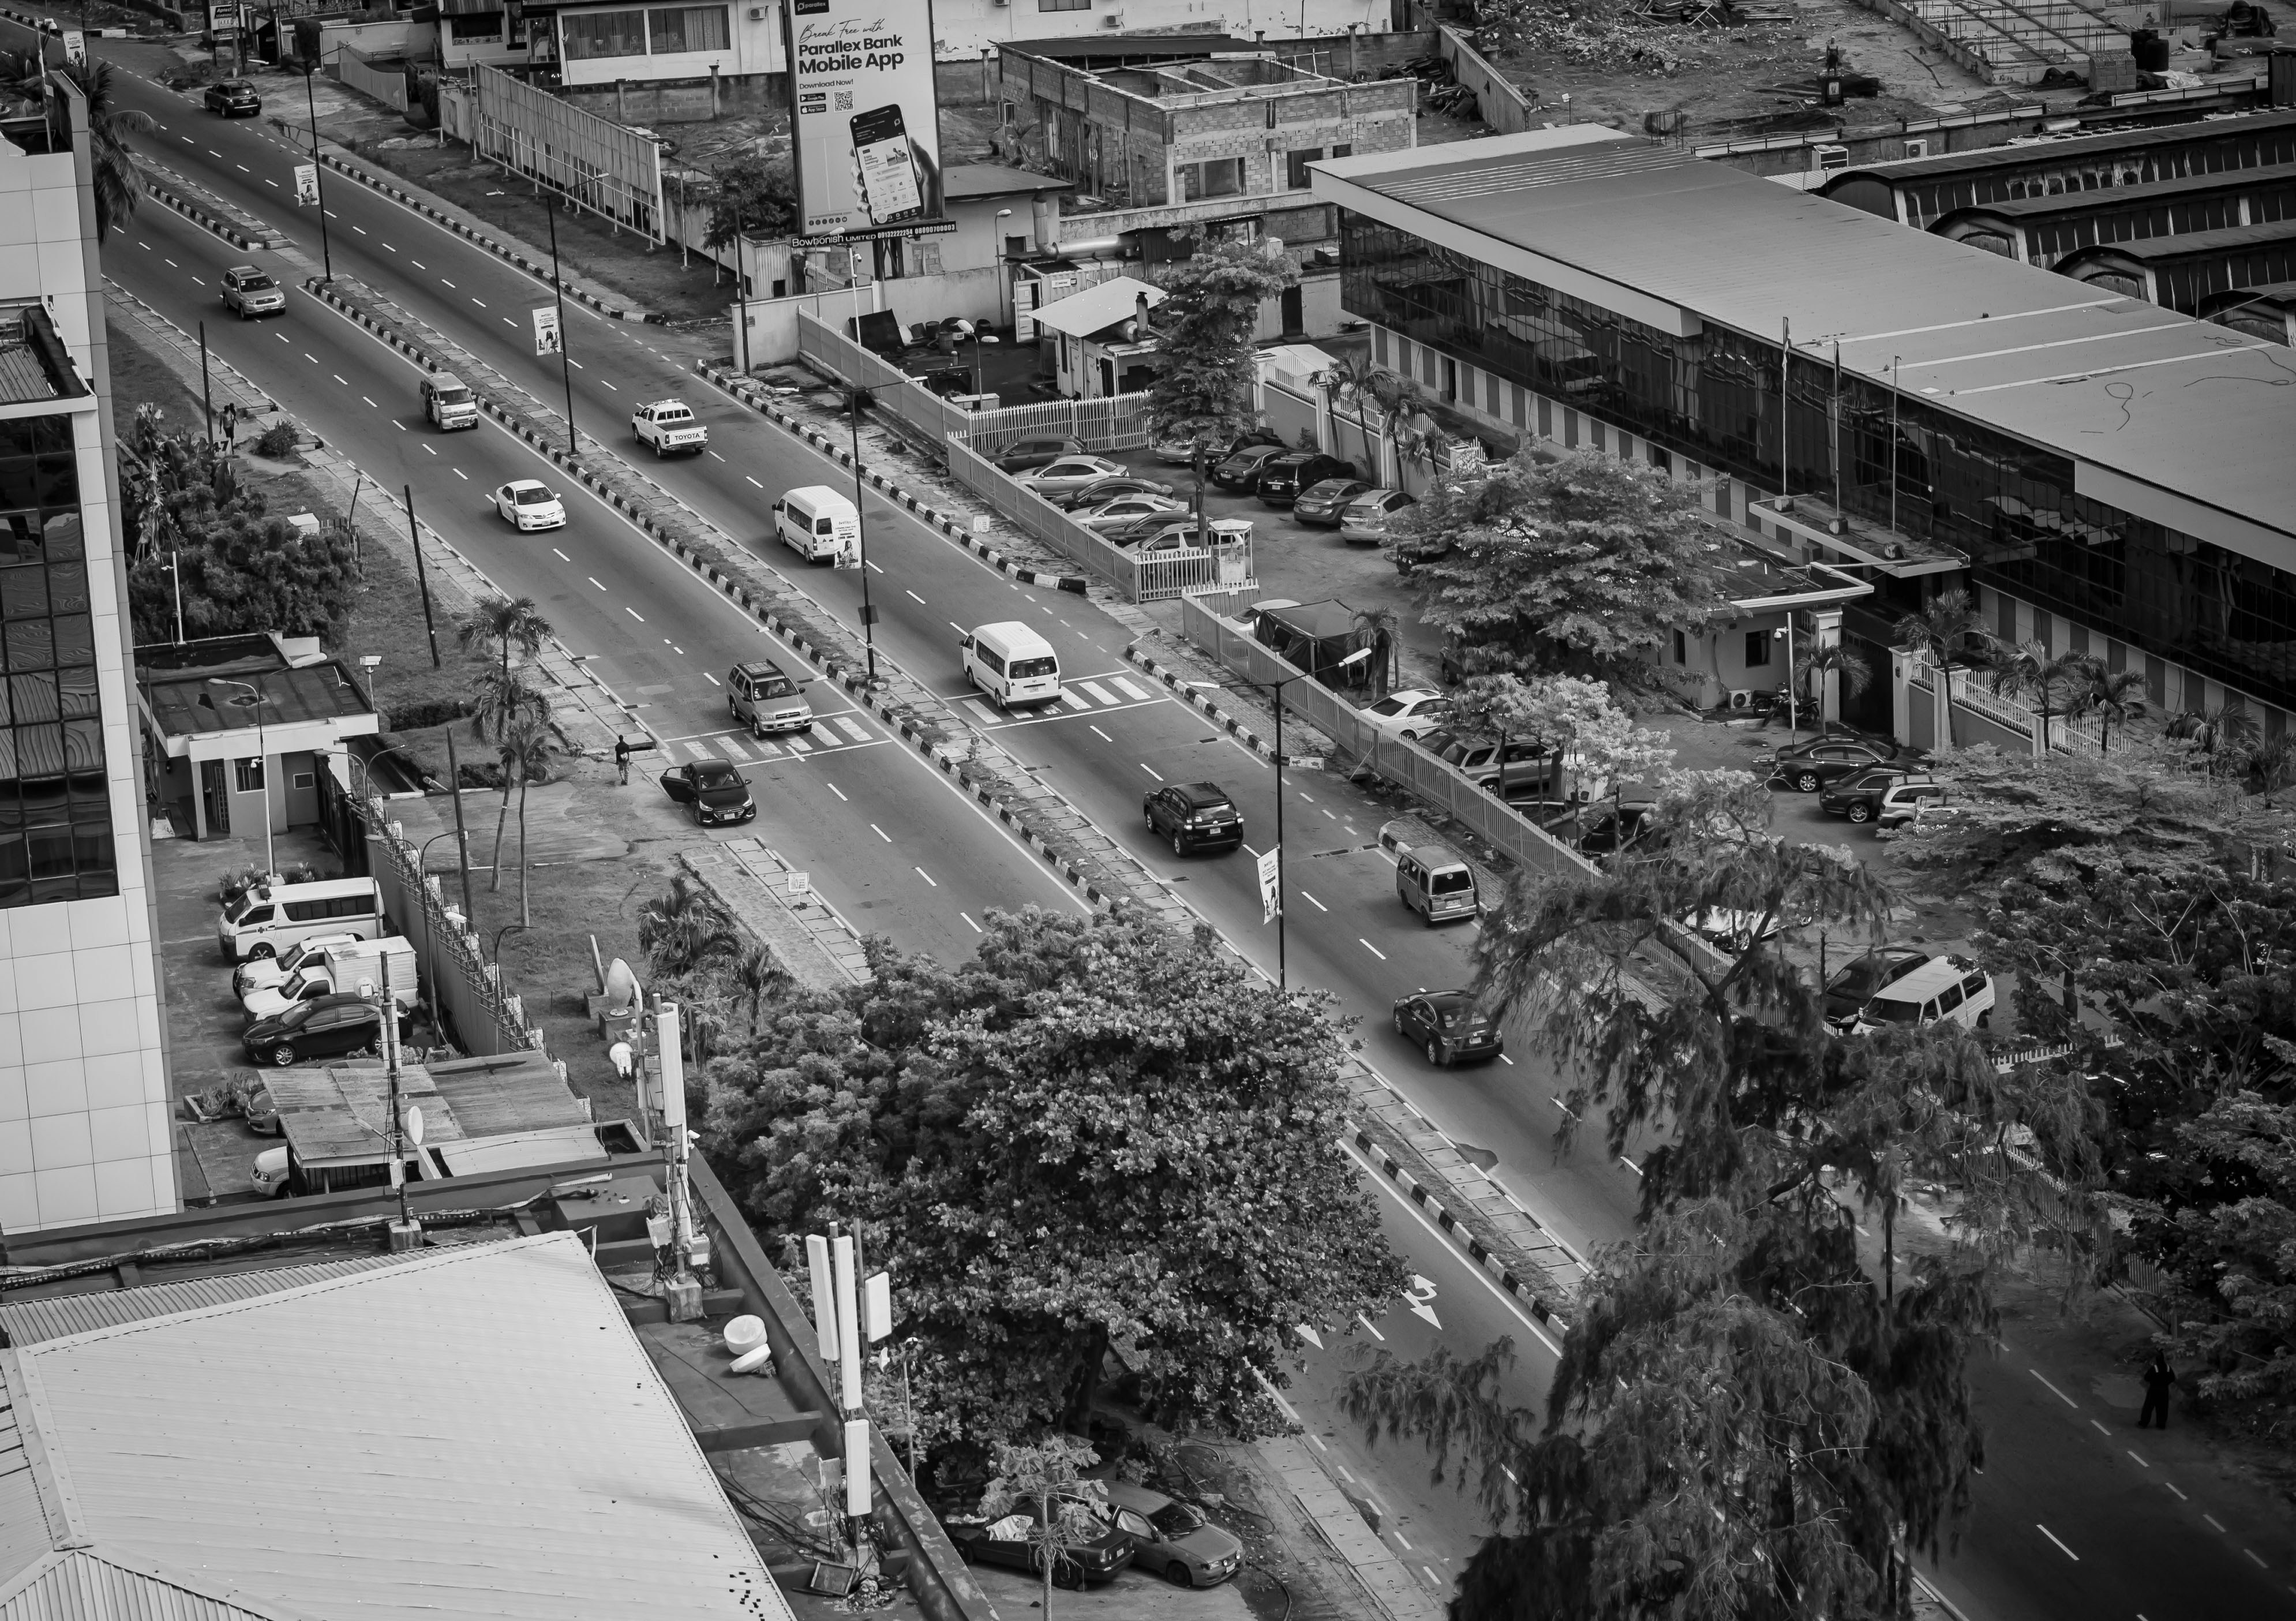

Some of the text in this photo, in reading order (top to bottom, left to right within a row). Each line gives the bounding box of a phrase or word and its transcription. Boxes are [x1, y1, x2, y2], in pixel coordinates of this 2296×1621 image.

[799, 18, 885, 43] Break Free with
[799, 34, 903, 57] Parallex Bank
[799, 52, 904, 74] Mobile App
[799, 78, 853, 89] Download Now!
[792, 234, 844, 247] Bowbonish
[878, 229, 913, 238] 09132222254
[675, 433, 700, 441] TOYOTA
